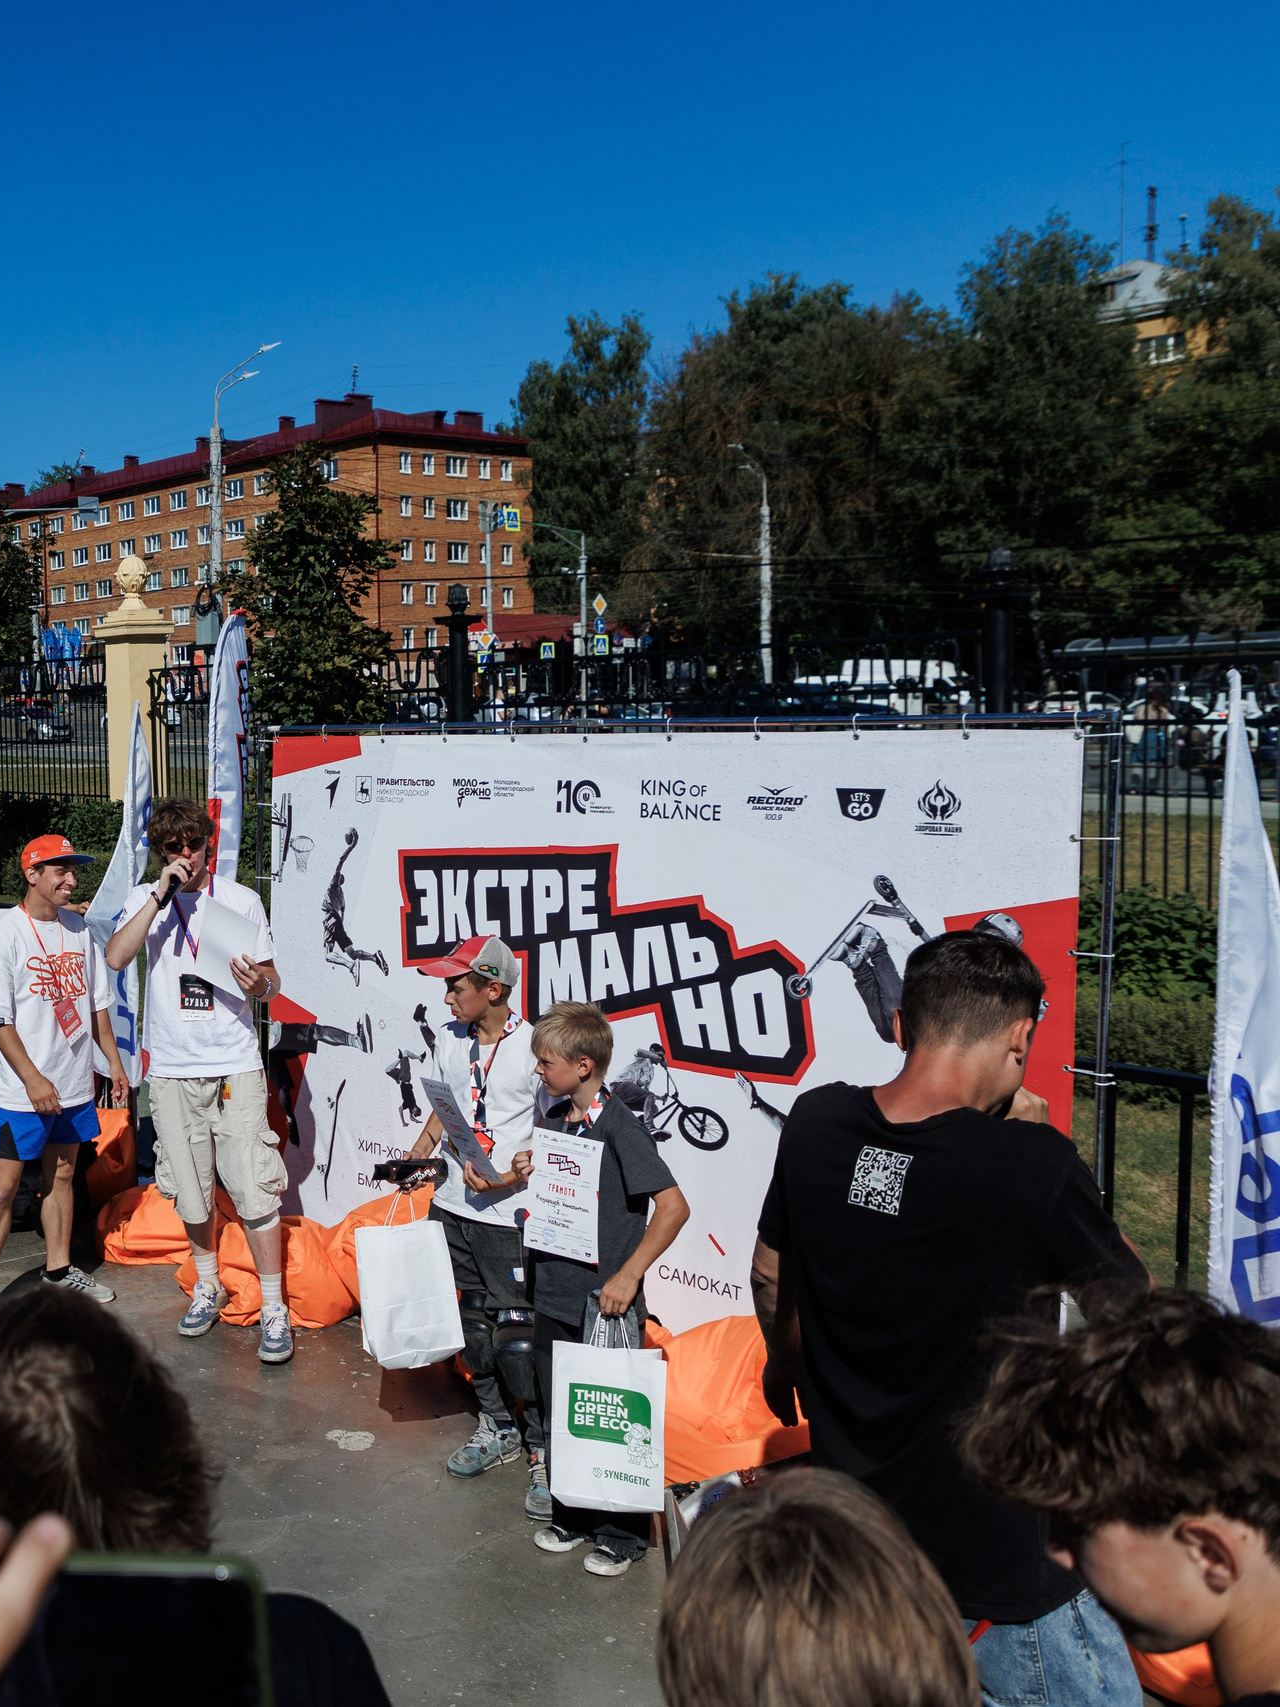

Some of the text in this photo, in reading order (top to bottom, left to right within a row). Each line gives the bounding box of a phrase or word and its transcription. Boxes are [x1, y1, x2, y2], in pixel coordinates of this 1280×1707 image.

[376, 778, 436, 787] ПРАВИТЕЛЬСТВО
[641, 779, 708, 798] KING OF
[376, 788, 430, 797] НИЖЕГОРОДСКОЙ
[376, 796, 404, 804] ОБЛАСТИ
[746, 796, 804, 806] RECORD
[764, 813, 783, 821] 100.9
[847, 802, 873, 817] GO
[914, 825, 963, 834] ЗДОРОВАЯ НАЦИЯ
[413, 868, 599, 946] ЭКСТРЕ
[538, 921, 720, 1016] МАЛЬ
[184, 997, 210, 1008] СУДЬЯ
[672, 967, 791, 1059] НО
[548, 1183, 576, 1198] ГРАМОТА
[658, 1264, 743, 1301] САМОКАТ
[574, 1388, 624, 1407] THINK
[574, 1401, 628, 1419] GREEN
[573, 1413, 632, 1432] BE ECO
[604, 1469, 651, 1488] SYNERGETIC
